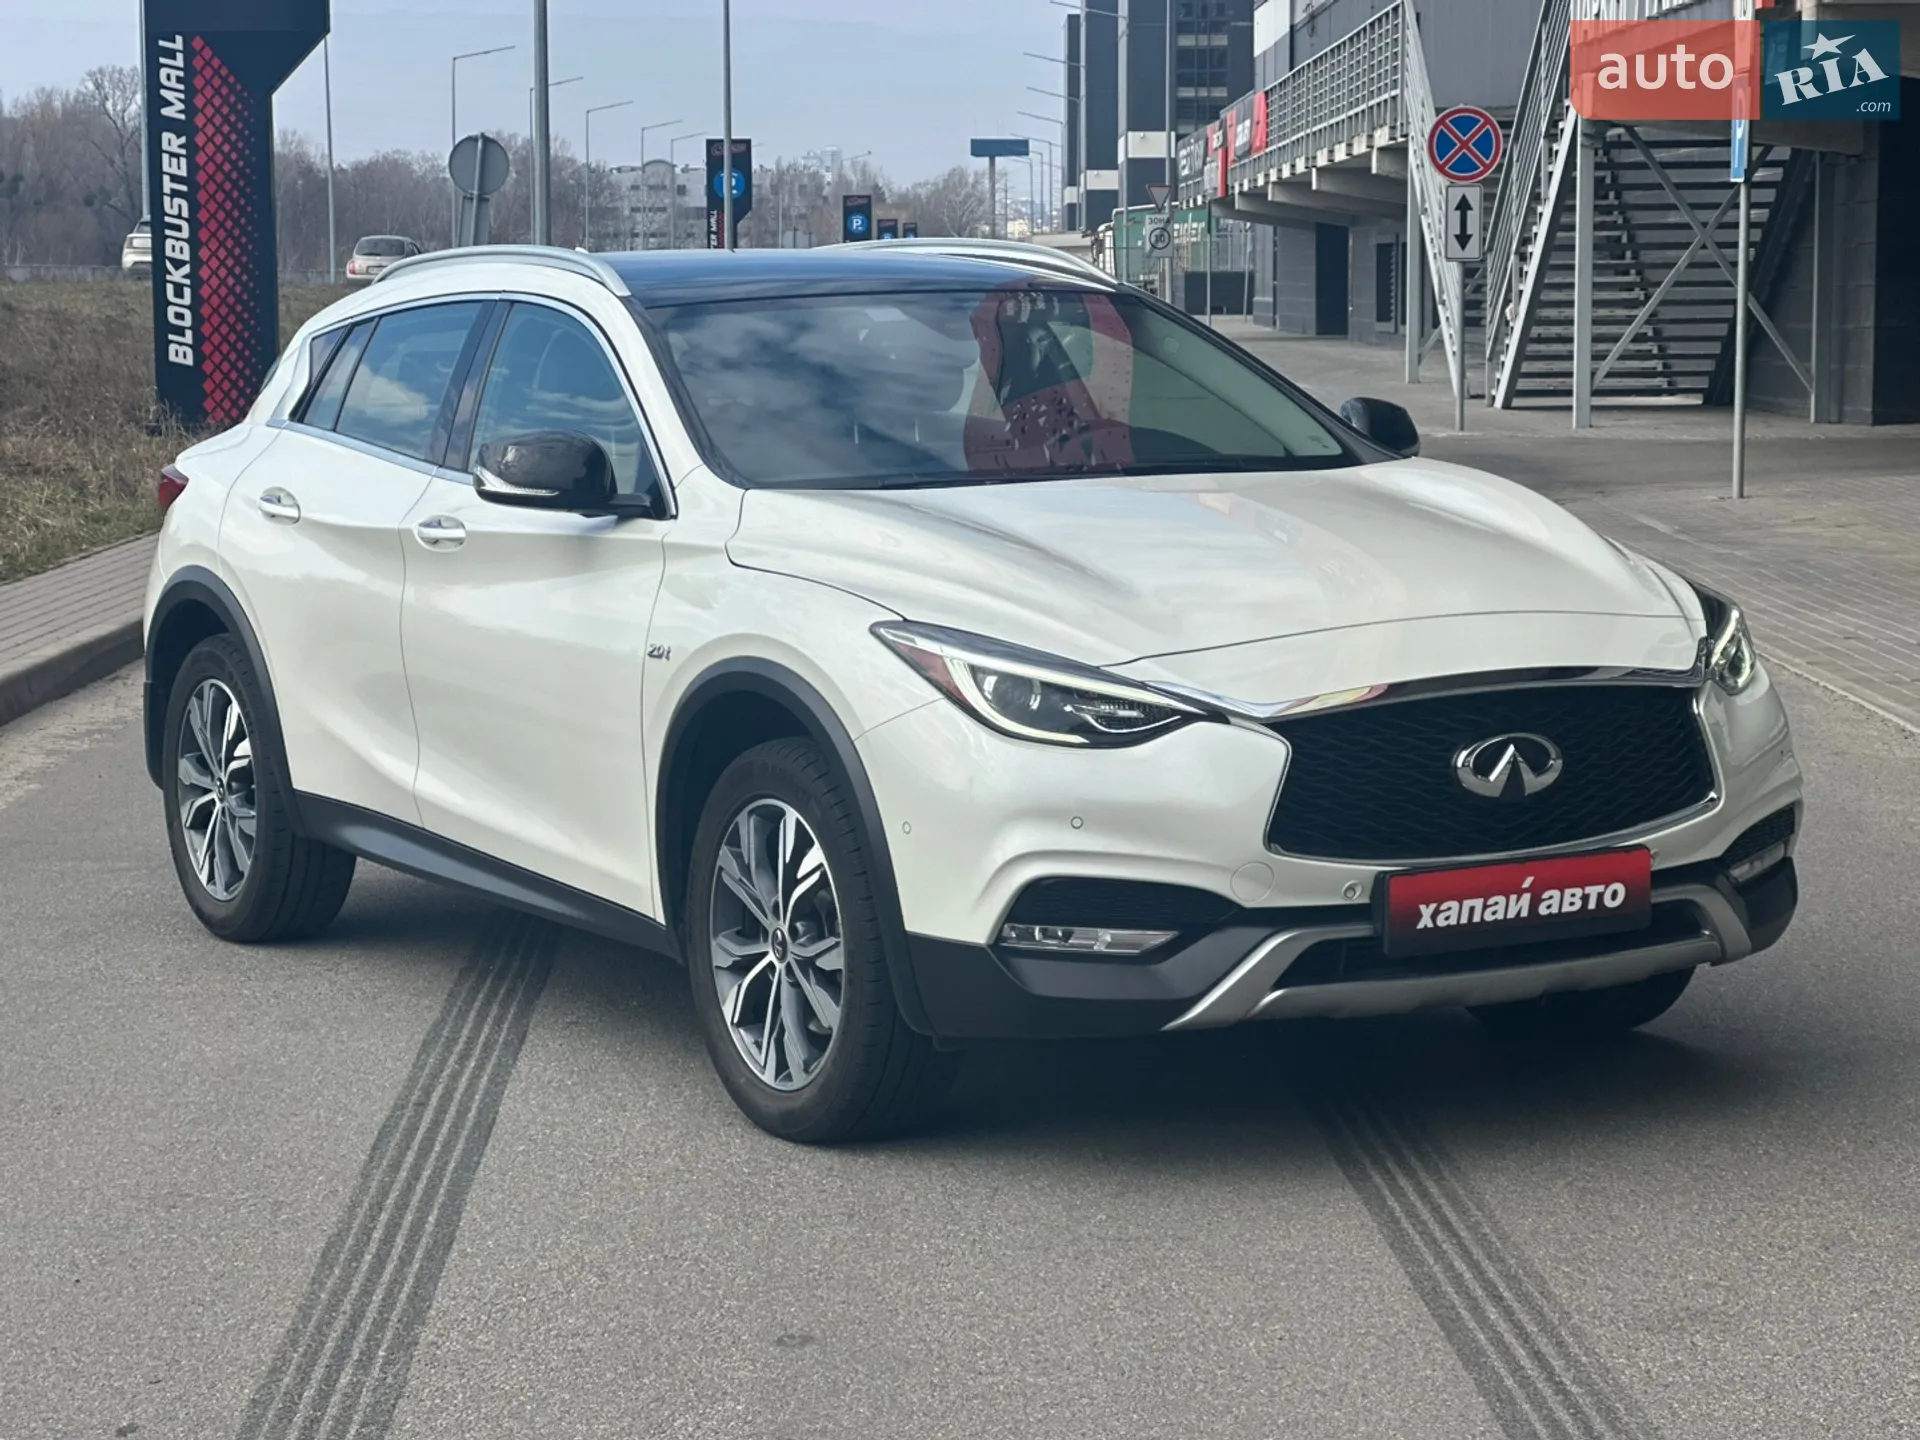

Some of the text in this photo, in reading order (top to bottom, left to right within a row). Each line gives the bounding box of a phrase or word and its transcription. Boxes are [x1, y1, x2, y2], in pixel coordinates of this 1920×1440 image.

[158, 34, 194, 366] BLOCKBUSTER MALL
[1148, 217, 1171, 226] ЗОНА
[1538, 882, 1626, 916] авто
